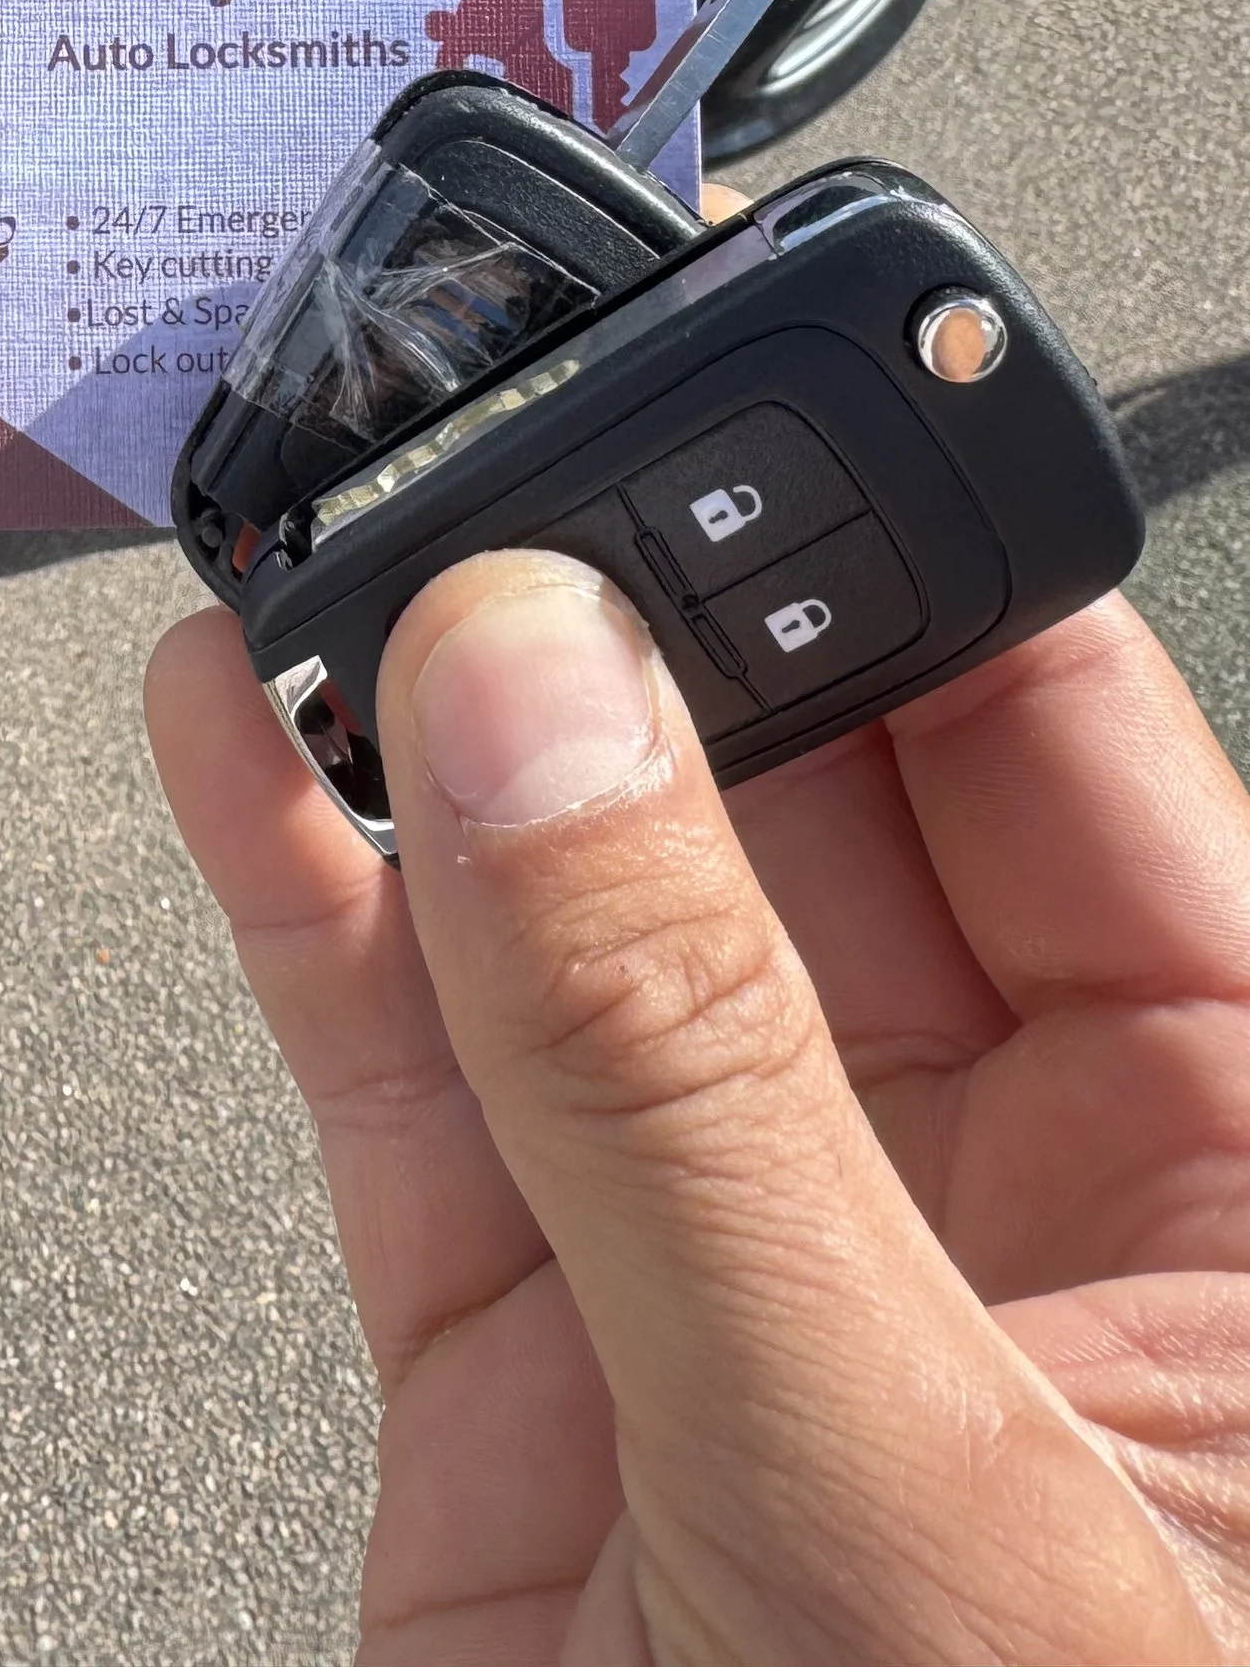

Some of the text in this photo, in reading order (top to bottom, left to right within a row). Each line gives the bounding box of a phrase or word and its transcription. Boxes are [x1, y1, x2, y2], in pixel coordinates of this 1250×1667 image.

[49, 31, 410, 71] Auto Locksmiths
[92, 205, 168, 235] 24/7
[94, 249, 273, 284] Key cutting
[88, 299, 153, 327] Lost
[161, 297, 186, 326] &
[96, 345, 168, 375] Lock
